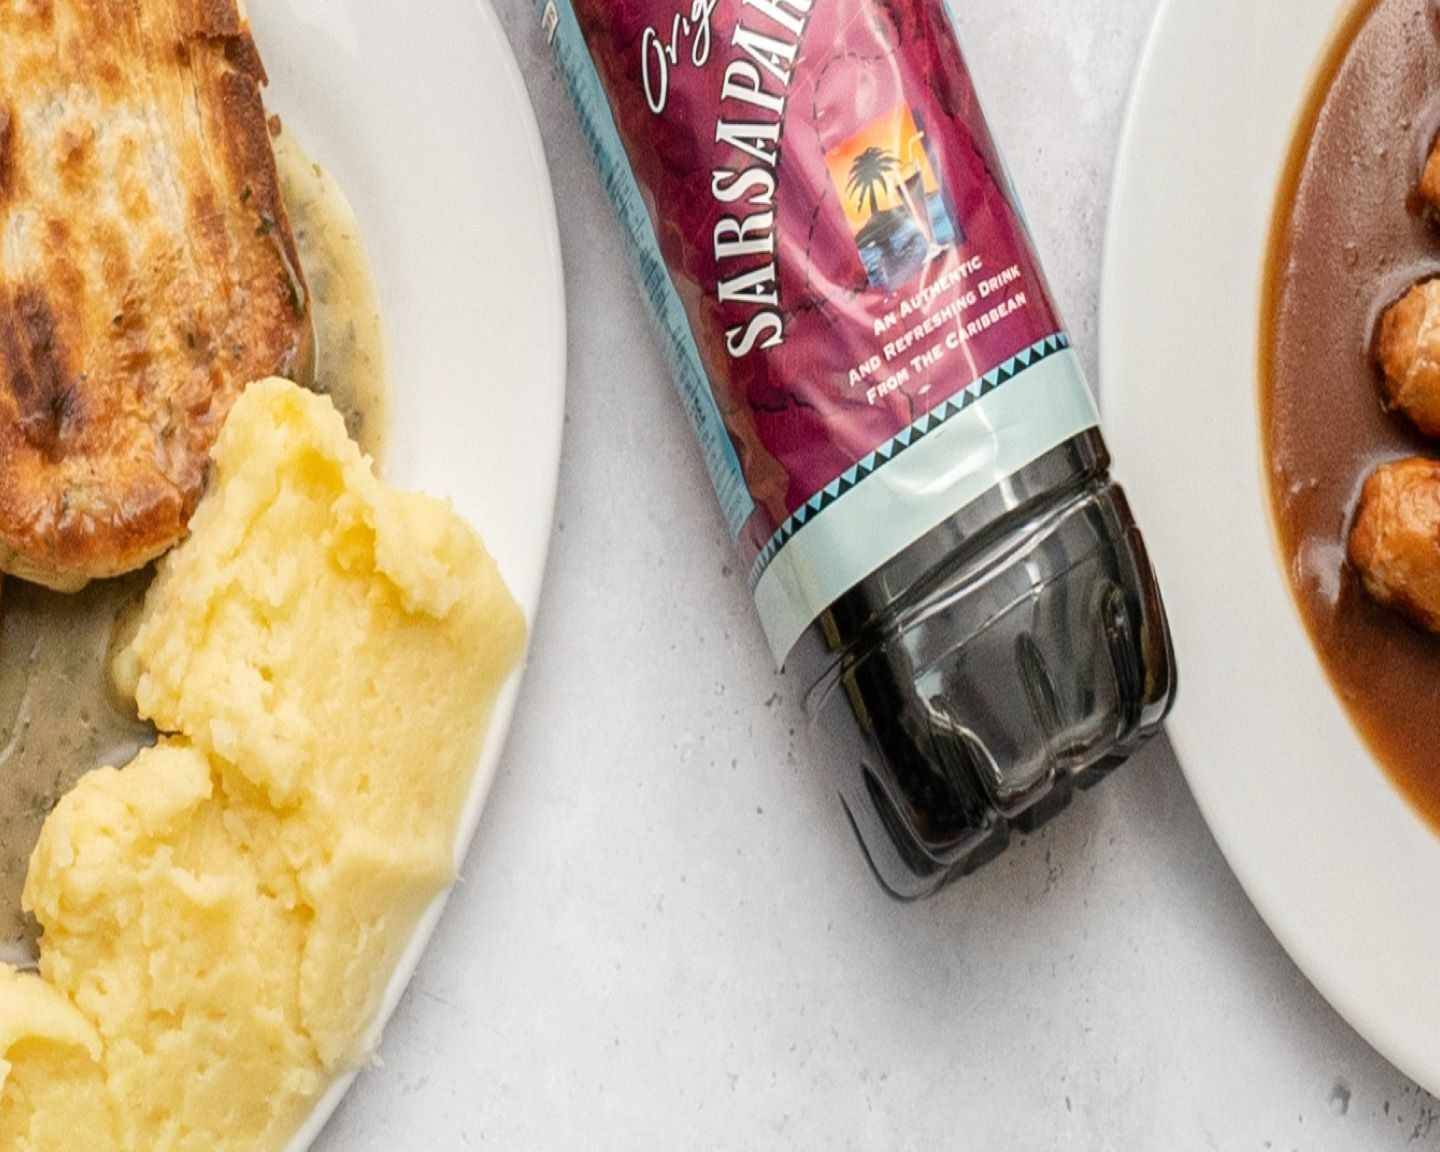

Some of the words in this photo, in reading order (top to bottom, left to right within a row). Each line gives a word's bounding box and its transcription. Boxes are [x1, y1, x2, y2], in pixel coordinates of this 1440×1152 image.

[847, 354, 882, 387] AND
[882, 291, 977, 361] REFRESHING
[977, 264, 1022, 298] DRINK
[899, 255, 984, 318] AUTHENTIC
[865, 368, 910, 405] FROM
[910, 343, 945, 373] THE
[944, 291, 1027, 350] CARIBBEAN
